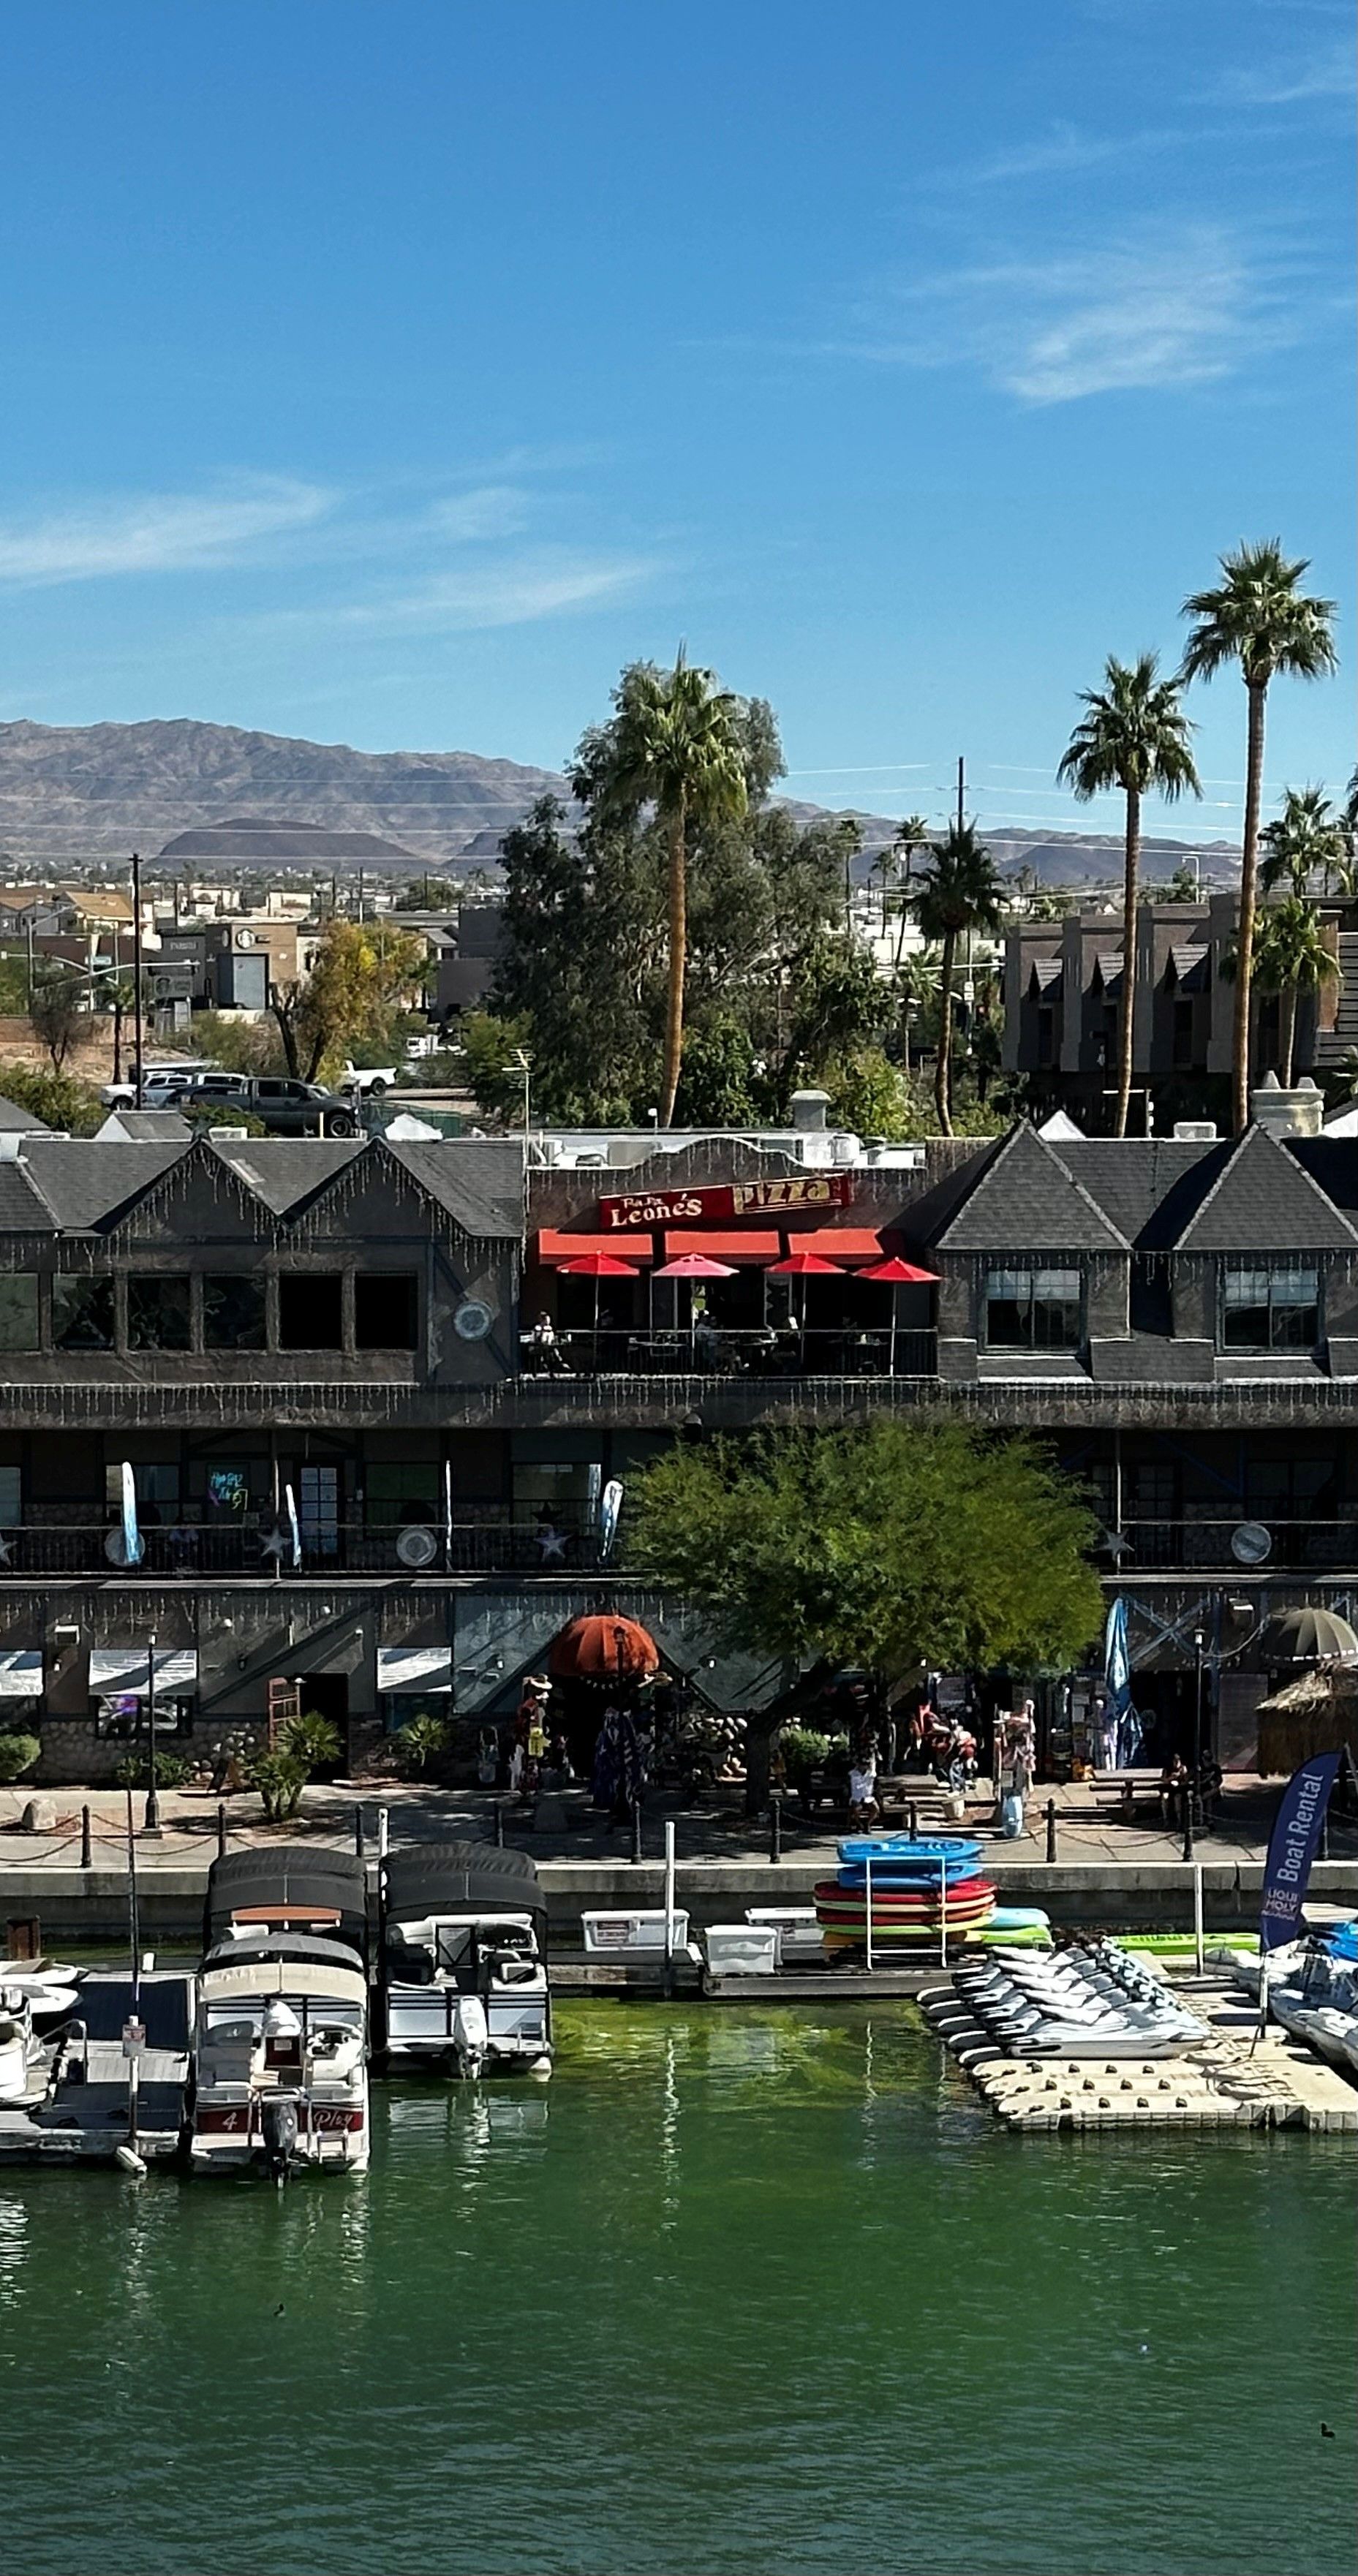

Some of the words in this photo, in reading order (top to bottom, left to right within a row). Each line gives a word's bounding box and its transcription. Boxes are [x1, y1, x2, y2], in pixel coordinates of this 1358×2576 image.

[1288, 1772, 1324, 1835] Rental
[1277, 1839, 1306, 1883] Boat
[222, 2112, 237, 2131] 4
[313, 2109, 353, 2130] Play
